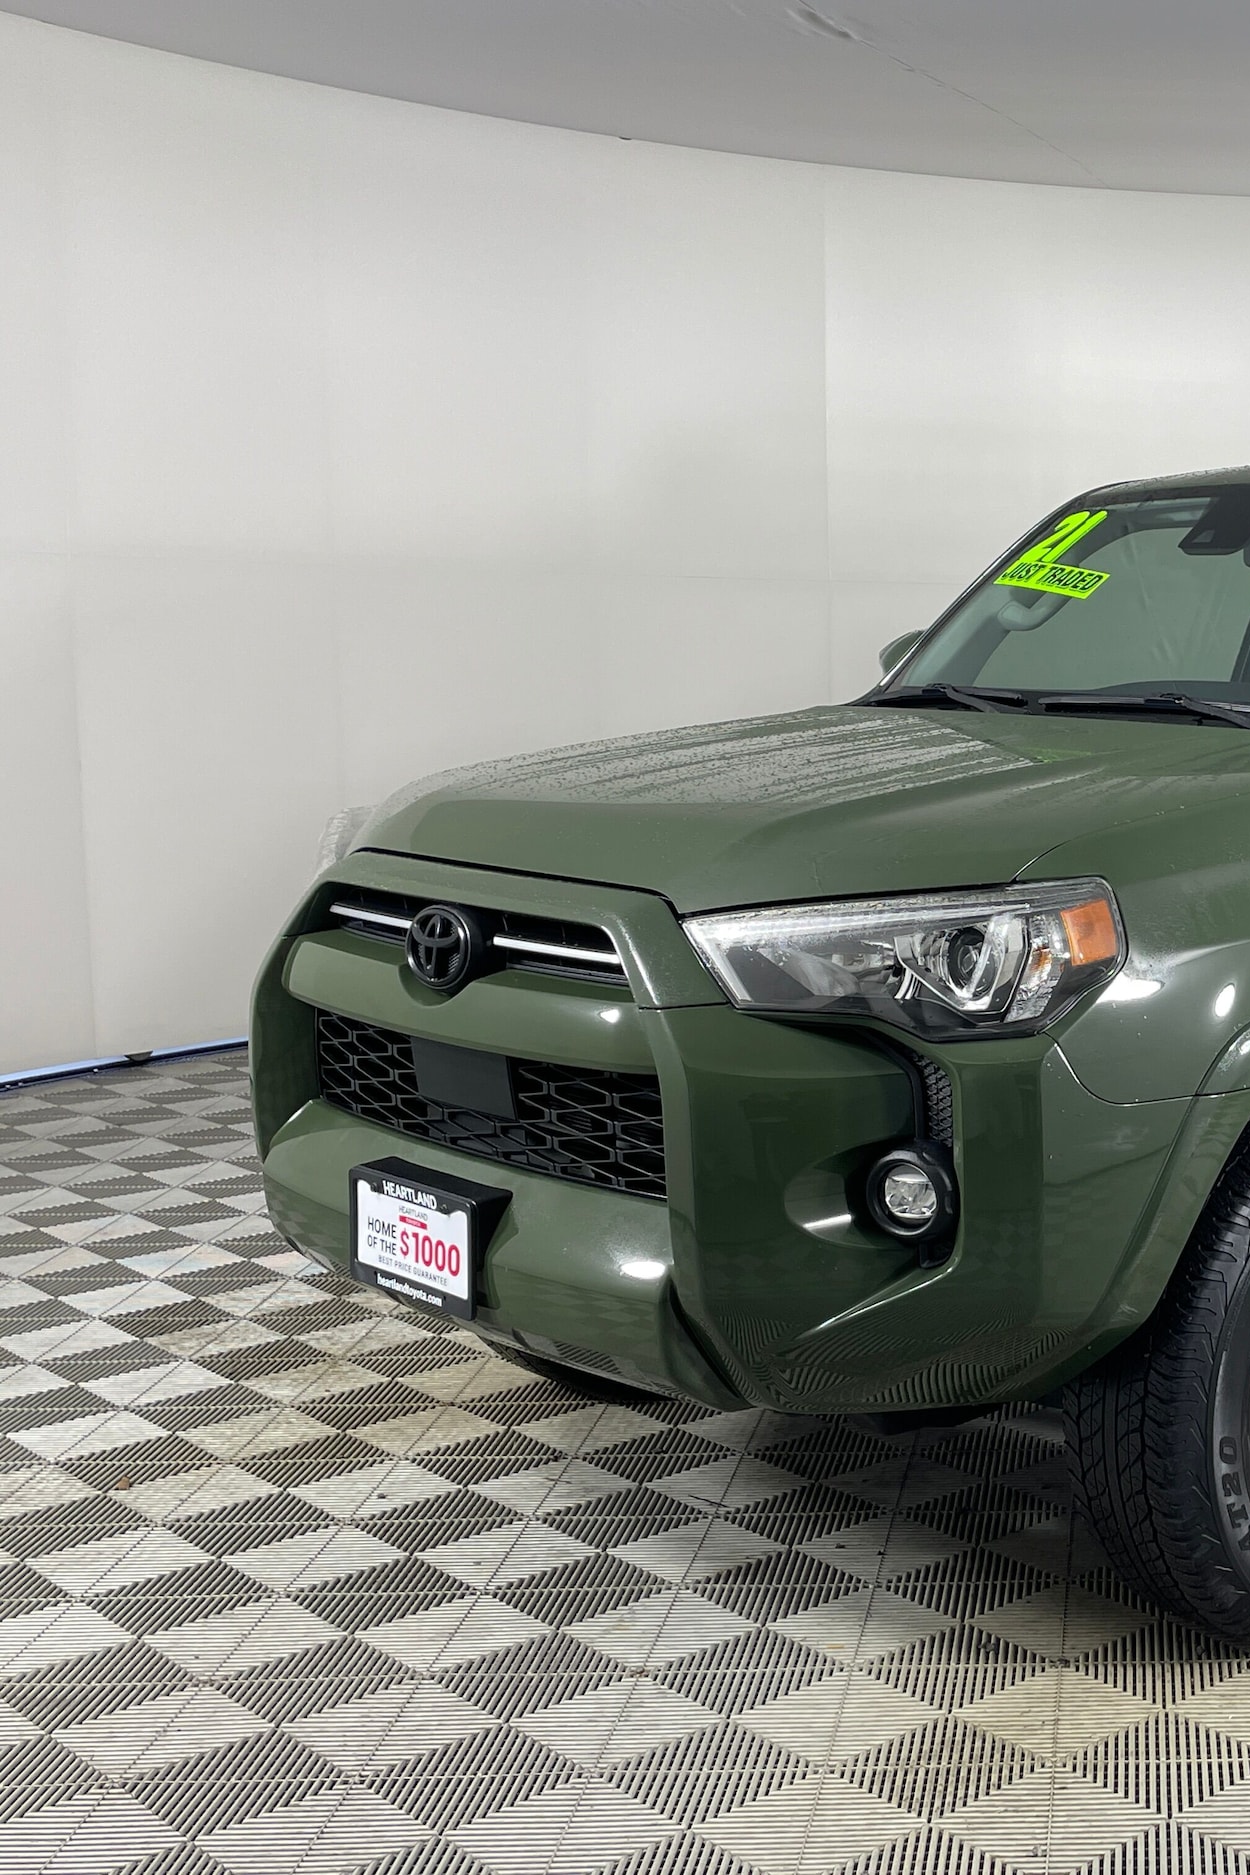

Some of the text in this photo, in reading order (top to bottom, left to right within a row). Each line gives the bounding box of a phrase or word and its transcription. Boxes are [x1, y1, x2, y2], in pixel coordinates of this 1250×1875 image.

[1001, 562, 1104, 593] JUST TRADED
[382, 1180, 438, 1210] HEARTLAND
[367, 1216, 397, 1239] HOME
[367, 1235, 397, 1256] OF THE
[400, 1229, 460, 1277] $1000
[378, 1255, 448, 1287] BEST PRICE GUARANTEE
[376, 1273, 443, 1307] heartlandtoyota.com
